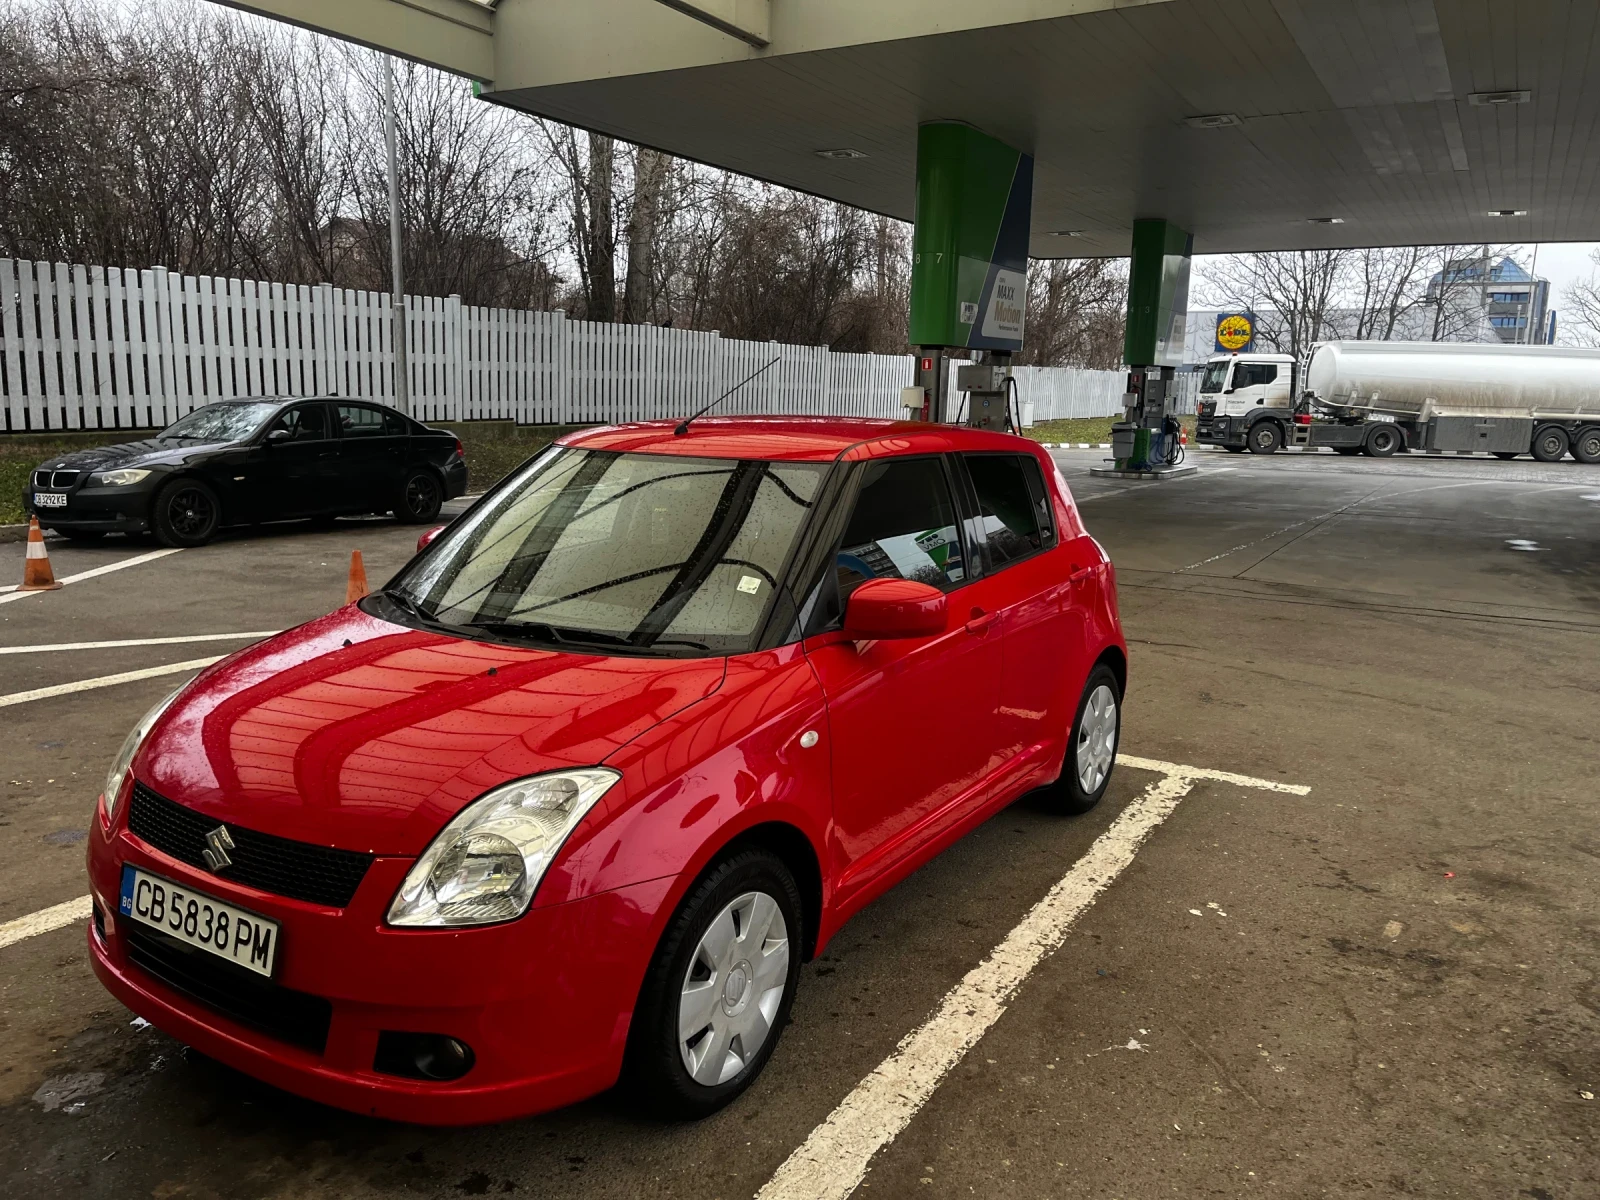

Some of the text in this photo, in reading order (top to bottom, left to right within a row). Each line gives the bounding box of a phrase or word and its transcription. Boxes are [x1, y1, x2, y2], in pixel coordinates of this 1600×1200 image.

[915, 253, 921, 264] 8
[936, 252, 943, 264] 7
[997, 285, 1016, 301] MAXX
[994, 301, 1021, 324] Motion
[122, 896, 132, 909] BG
[135, 879, 272, 969] CB 5838 PM
